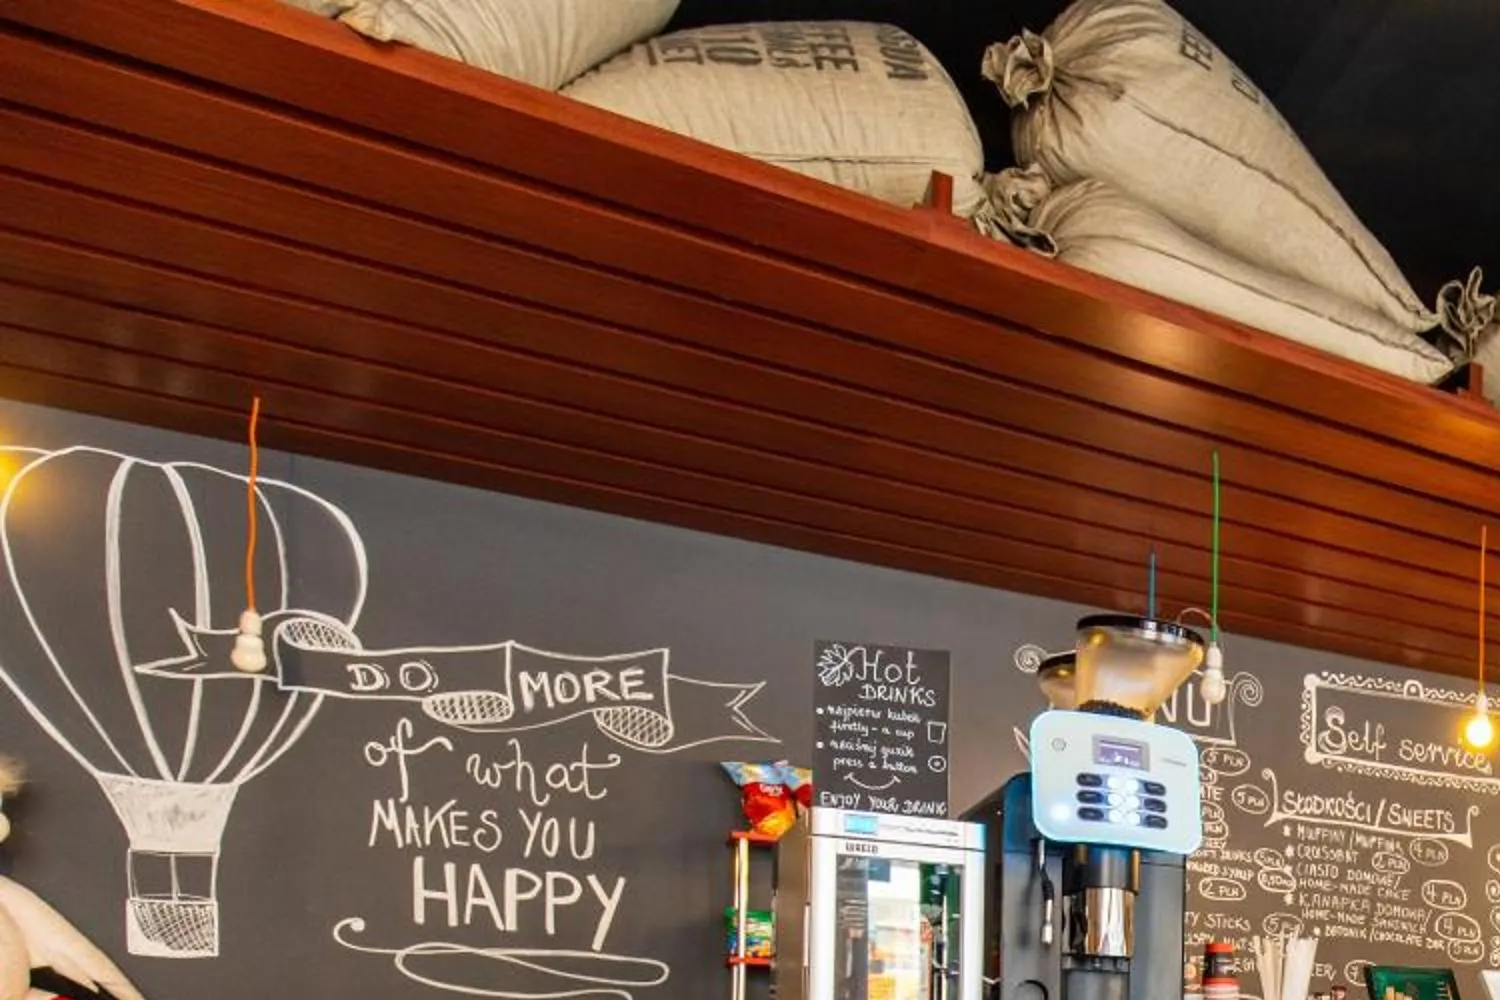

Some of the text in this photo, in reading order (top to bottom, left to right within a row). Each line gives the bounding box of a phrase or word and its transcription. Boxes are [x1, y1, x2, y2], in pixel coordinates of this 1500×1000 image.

[347, 660, 653, 712] DO MORE
[848, 646, 920, 685] Hot
[857, 683, 936, 707] DRINKS
[1317, 705, 1488, 773] Self service
[364, 717, 621, 807] of what
[368, 798, 595, 861] MAKES YOU
[1387, 804, 1456, 834] SWEETS
[413, 855, 627, 952] HAPPY
[1218, 885, 1240, 897] PLN
[1203, 913, 1251, 933] STICKS
